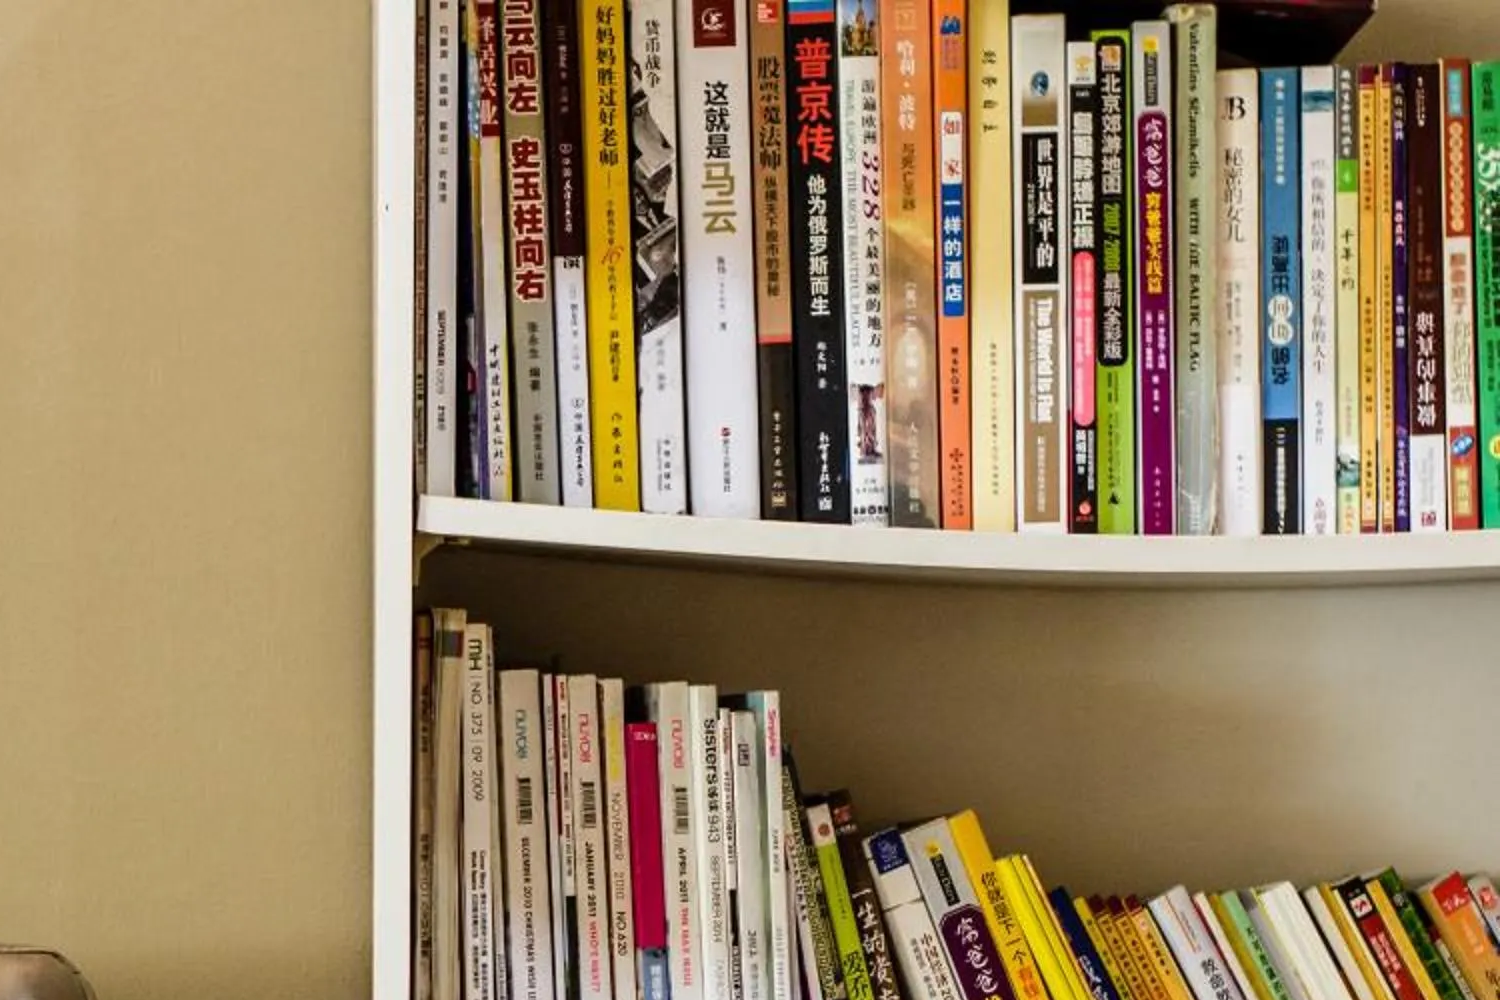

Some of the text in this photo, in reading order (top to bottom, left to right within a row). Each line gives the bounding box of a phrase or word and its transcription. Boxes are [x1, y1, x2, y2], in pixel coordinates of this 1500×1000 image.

[595, 6, 620, 167] 好妈妈胜过好老师
[644, 19, 662, 89] 货币战争
[757, 57, 782, 171] 股票魔法师
[794, 37, 836, 165] 普京传
[702, 80, 737, 236] 这就是马云
[510, 137, 547, 303] 史玉柱向右
[1036, 138, 1055, 269] 世界是平的
[807, 175, 832, 317] 他为俄罗斯而生
[1188, 273, 1201, 327] BALTIC
[1036, 328, 1054, 374] World
[1188, 331, 1201, 372] FLAG
[585, 841, 595, 891] JANUARY
[678, 847, 688, 877] APRIL
[679, 880, 689, 903] 2011
[524, 911, 535, 963] CHRISTMAS
